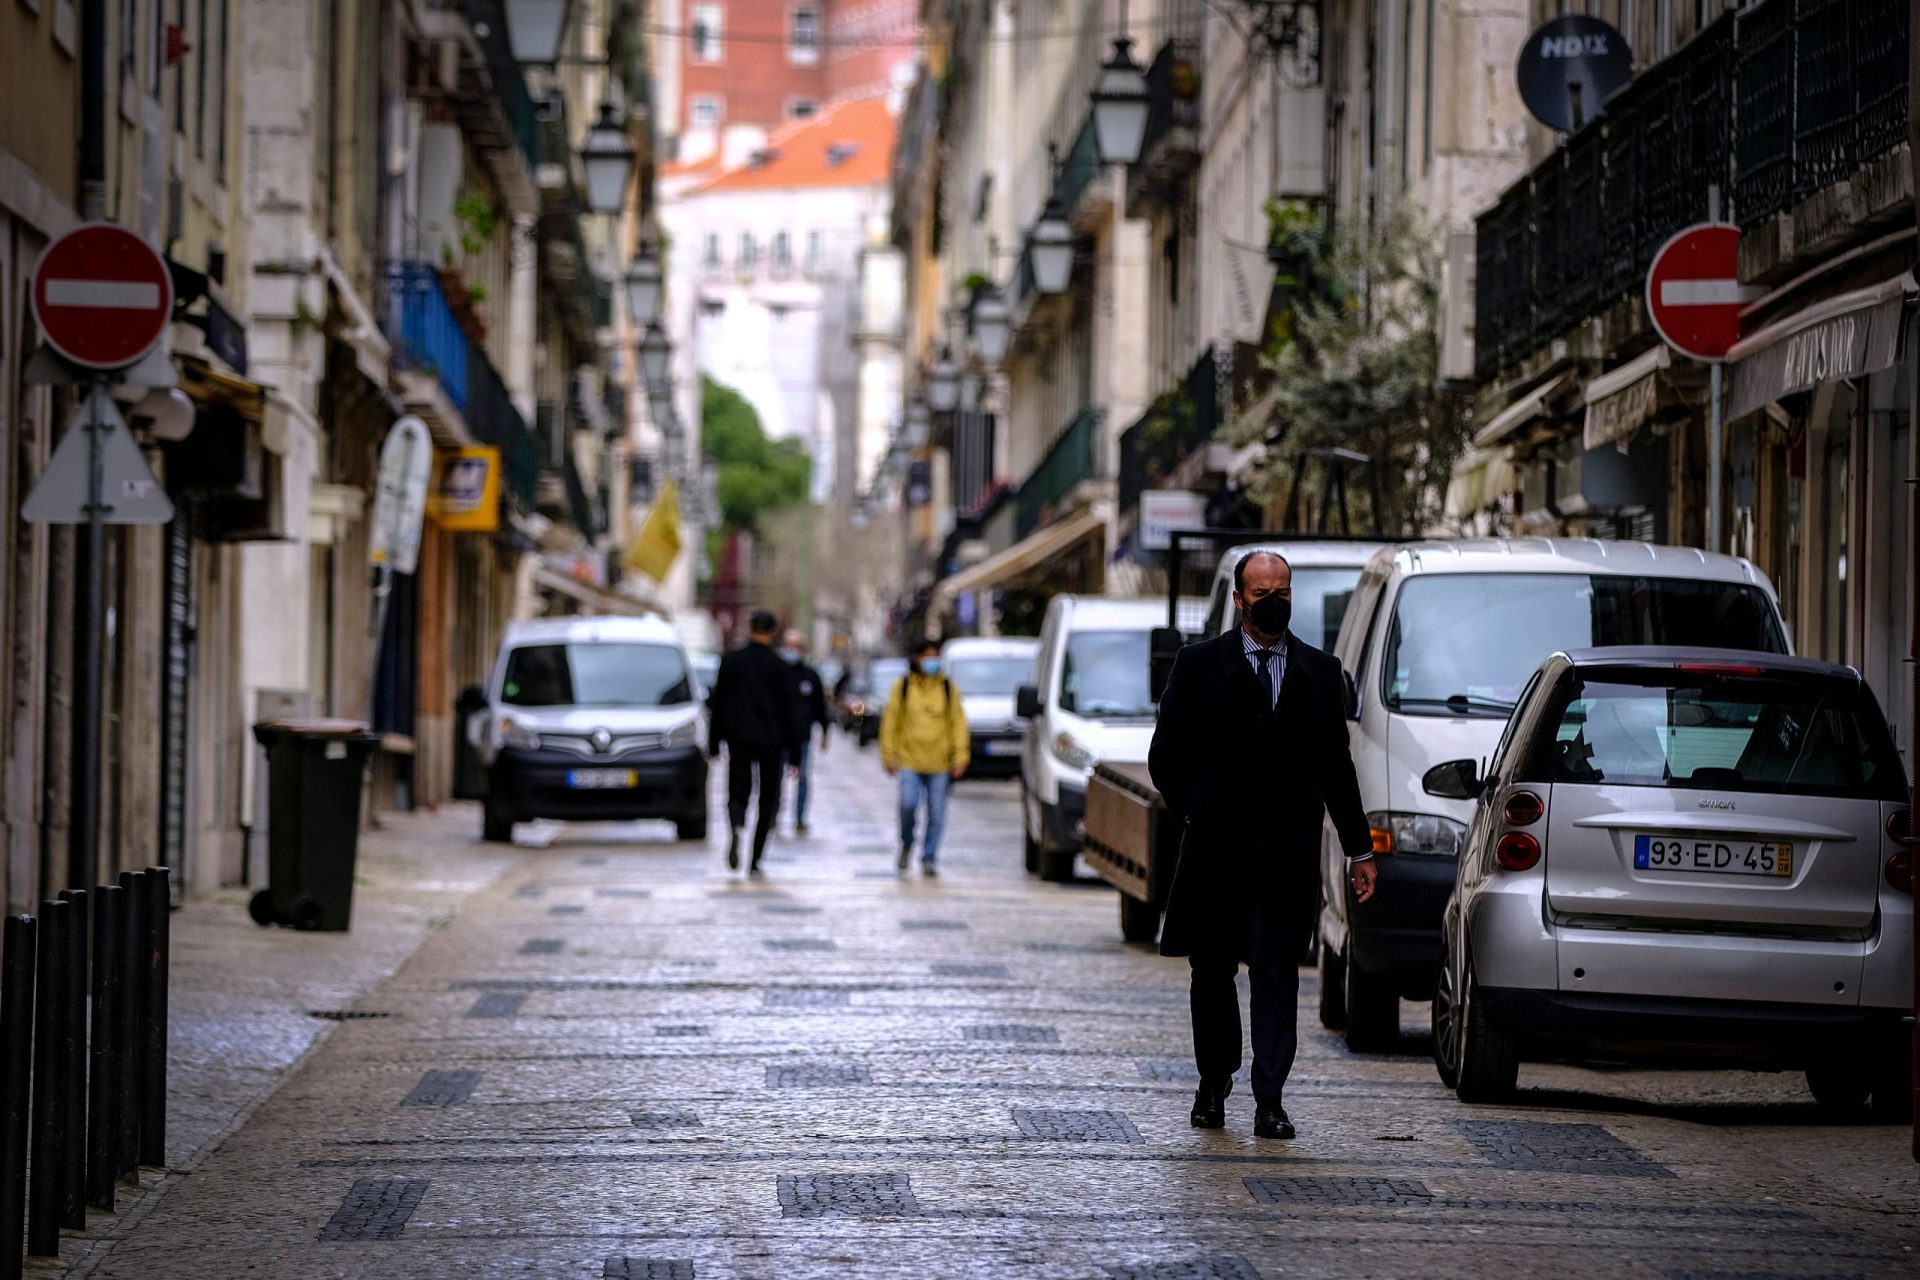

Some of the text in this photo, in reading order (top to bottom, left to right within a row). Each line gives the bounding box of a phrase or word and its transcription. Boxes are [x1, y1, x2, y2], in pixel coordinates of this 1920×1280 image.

[1699, 799, 1736, 810] smart
[1778, 847, 1790, 857] 07
[1778, 862, 1789, 873] 08
